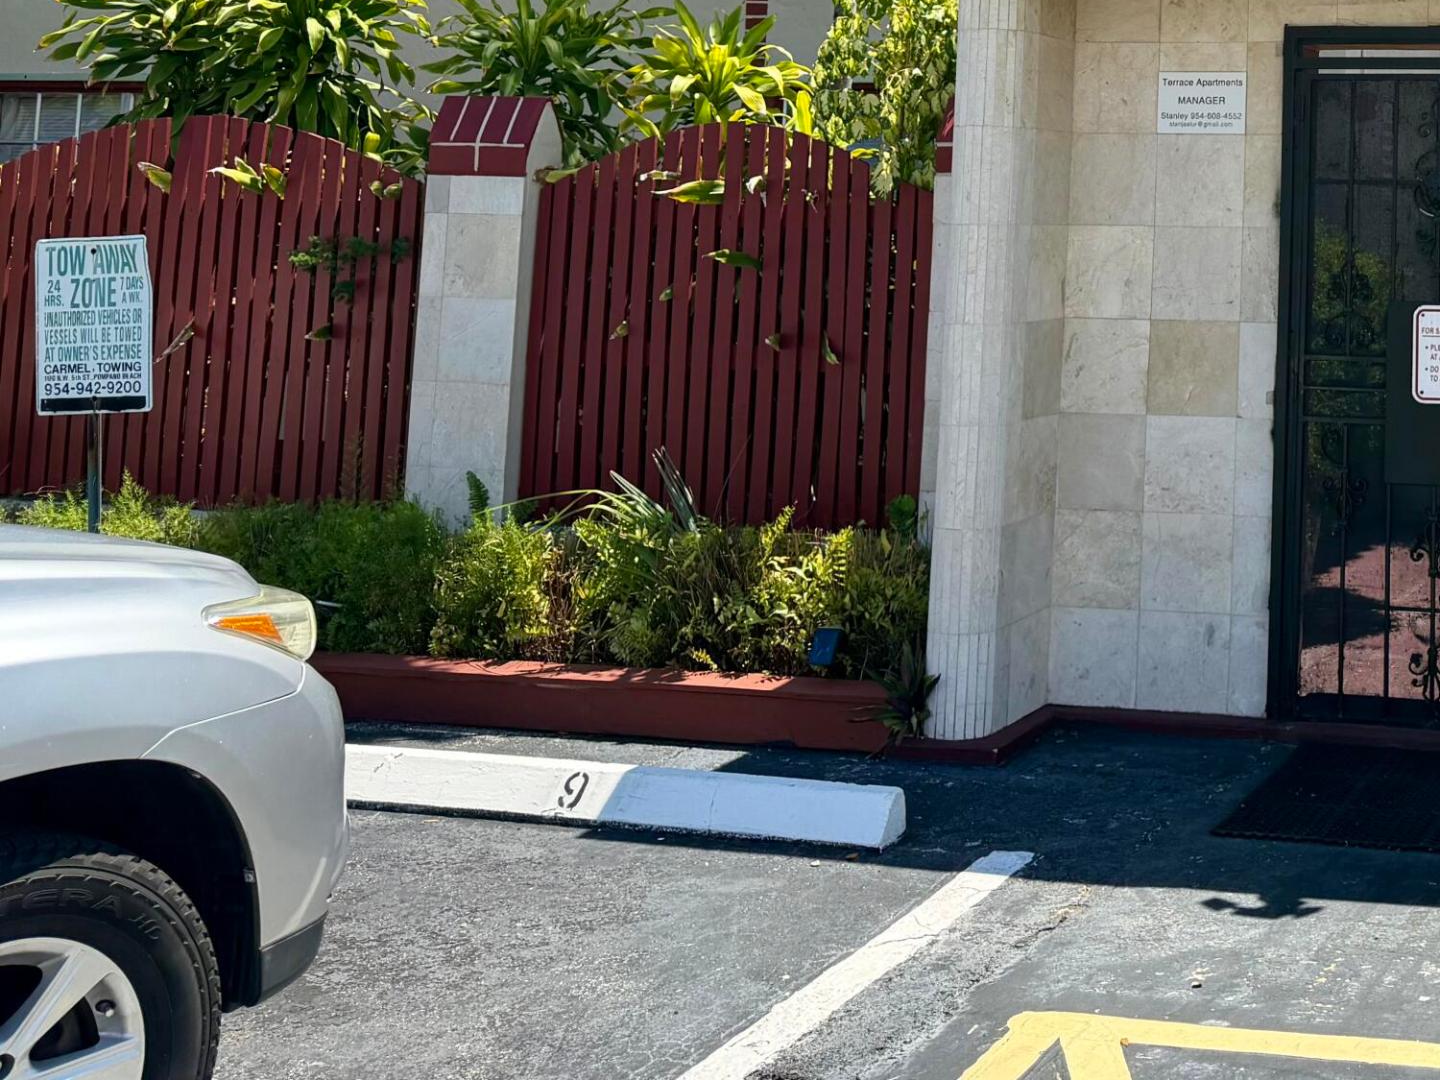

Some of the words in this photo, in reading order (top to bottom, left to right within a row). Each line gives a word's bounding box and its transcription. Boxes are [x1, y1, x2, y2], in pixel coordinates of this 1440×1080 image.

[1162, 78, 1194, 87] Terrace
[1196, 78, 1243, 87] Apartments
[1177, 96, 1226, 105] MANAGER
[44, 245, 87, 277] TOW
[93, 243, 138, 275] AWAY
[47, 280, 61, 293] 24
[120, 277, 125, 290] 7
[126, 276, 144, 290] DAYS
[70, 277, 117, 309] ZONE
[122, 292, 127, 303] A
[44, 295, 65, 307] HRS.
[44, 310, 96, 328] UNAUTHORIZED
[98, 308, 131, 325] VEHICLES
[132, 308, 142, 324] OR
[44, 328, 77, 345] VESSELS
[80, 328, 98, 344] WILL
[101, 327, 111, 342] BE
[114, 326, 142, 342] TOWED
[44, 346, 55, 362] AT
[58, 345, 98, 362] OWNER'S
[101, 343, 142, 361] EXPENSE
[1430, 353, 1438, 361] AT
[97, 361, 142, 373] TOWING
[1430, 365, 1439, 373] DO
[44, 381, 142, 396] 954-942-9200
[557, 771, 589, 810] 9
